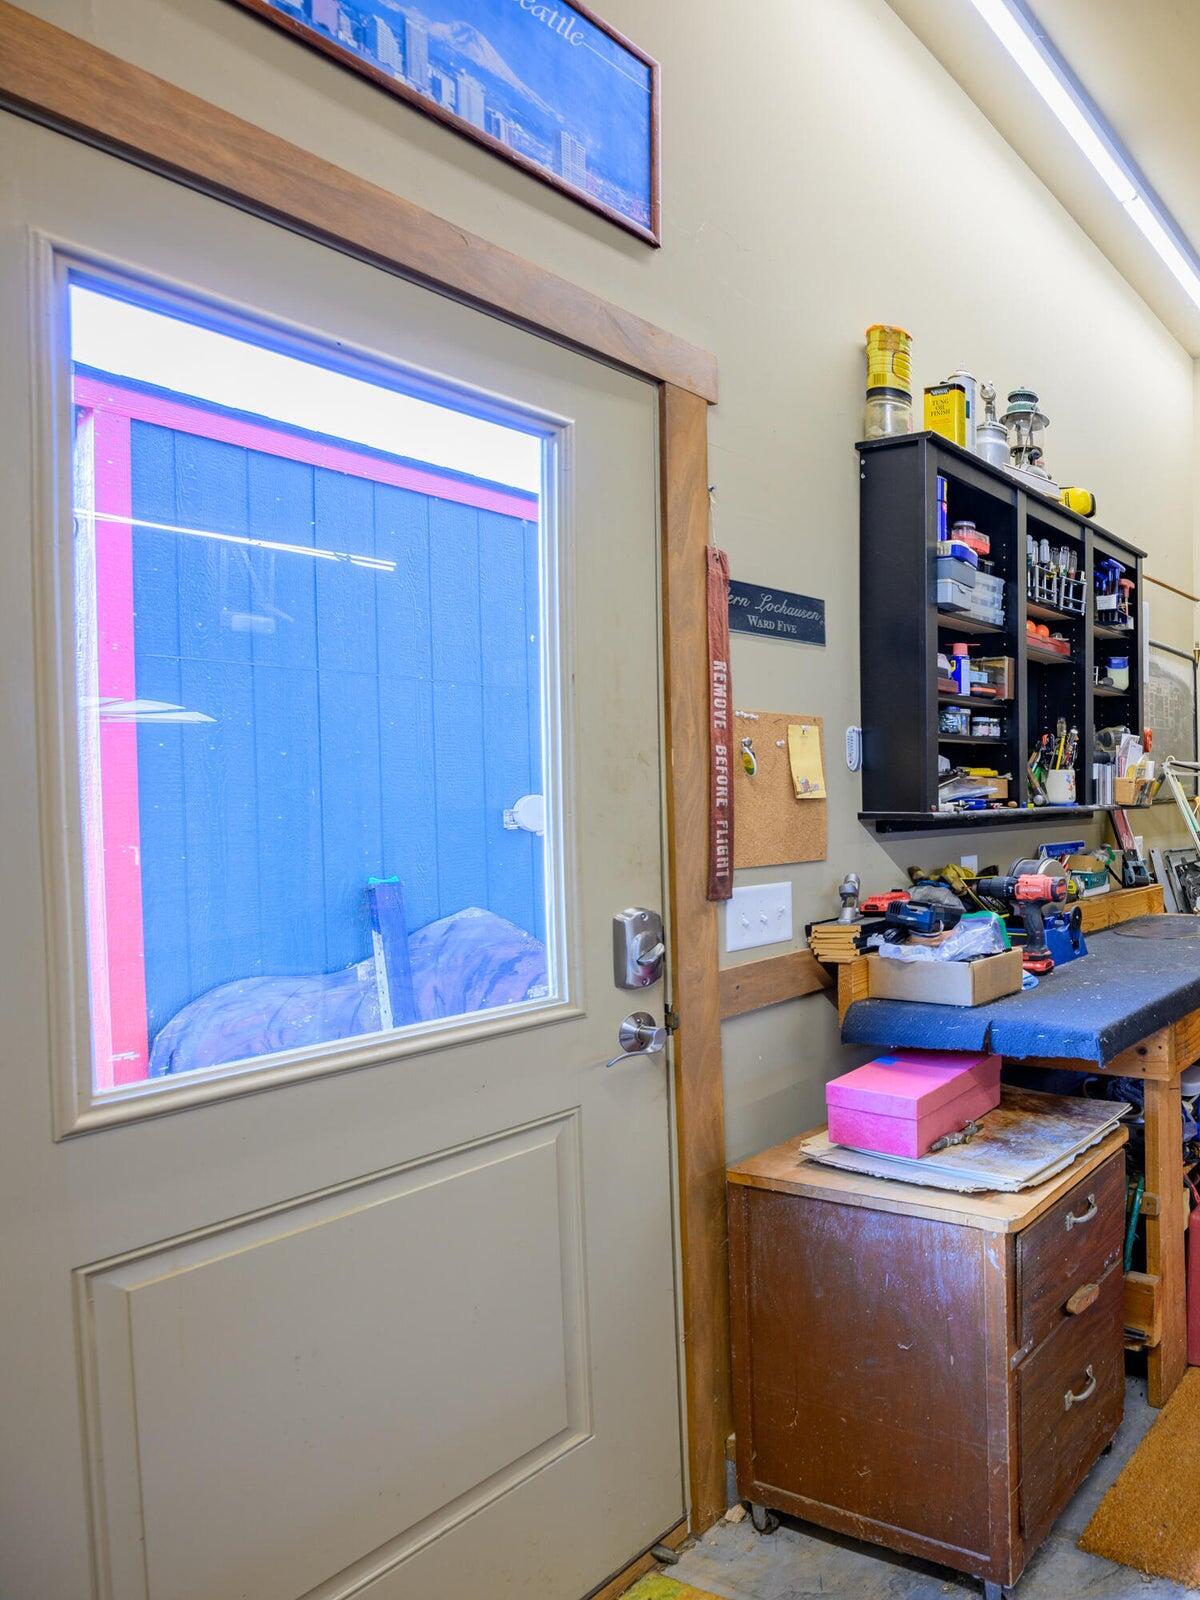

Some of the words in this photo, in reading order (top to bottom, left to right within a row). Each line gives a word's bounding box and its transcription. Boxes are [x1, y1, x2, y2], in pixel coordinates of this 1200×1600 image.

[514, 0, 584, 46] eattle
[930, 409, 950, 417] FINISH
[727, 586, 751, 607] ern
[713, 660, 727, 730] REMOVE
[715, 745, 729, 808] BEFORE
[716, 820, 729, 878] FLIGHT
